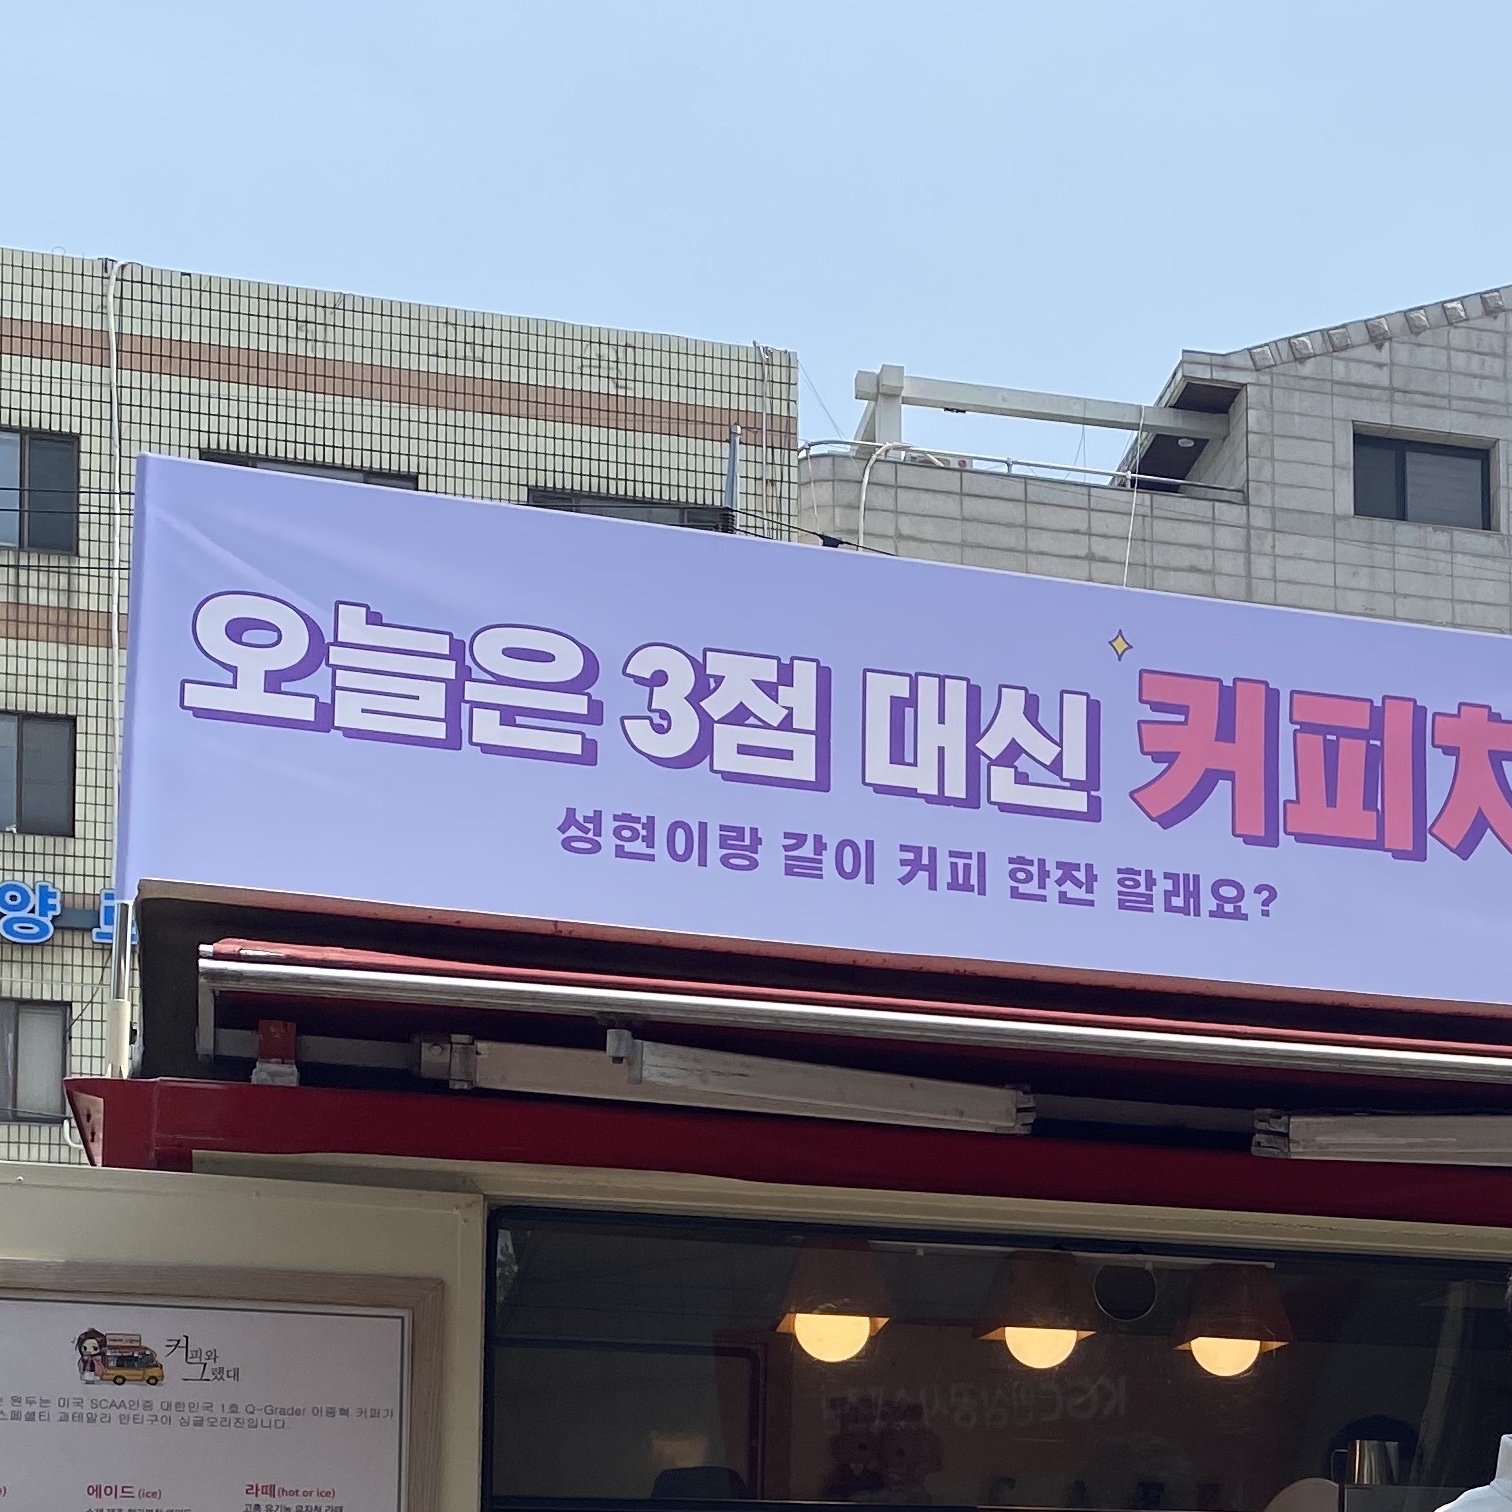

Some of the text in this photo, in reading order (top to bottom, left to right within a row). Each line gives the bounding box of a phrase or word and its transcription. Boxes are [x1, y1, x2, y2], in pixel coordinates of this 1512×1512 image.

[180, 590, 603, 767] 오늘은
[620, 641, 832, 792] 3점
[862, 668, 1102, 822] 대신
[556, 806, 1279, 922] 성현이랑 같이 커피 한잔 할래요?
[87, 1484, 161, 1500] 에이드 (ice)
[245, 1483, 275, 1498] 라떼
[278, 1487, 299, 1498] (hot
[317, 1488, 335, 1499] ice)
